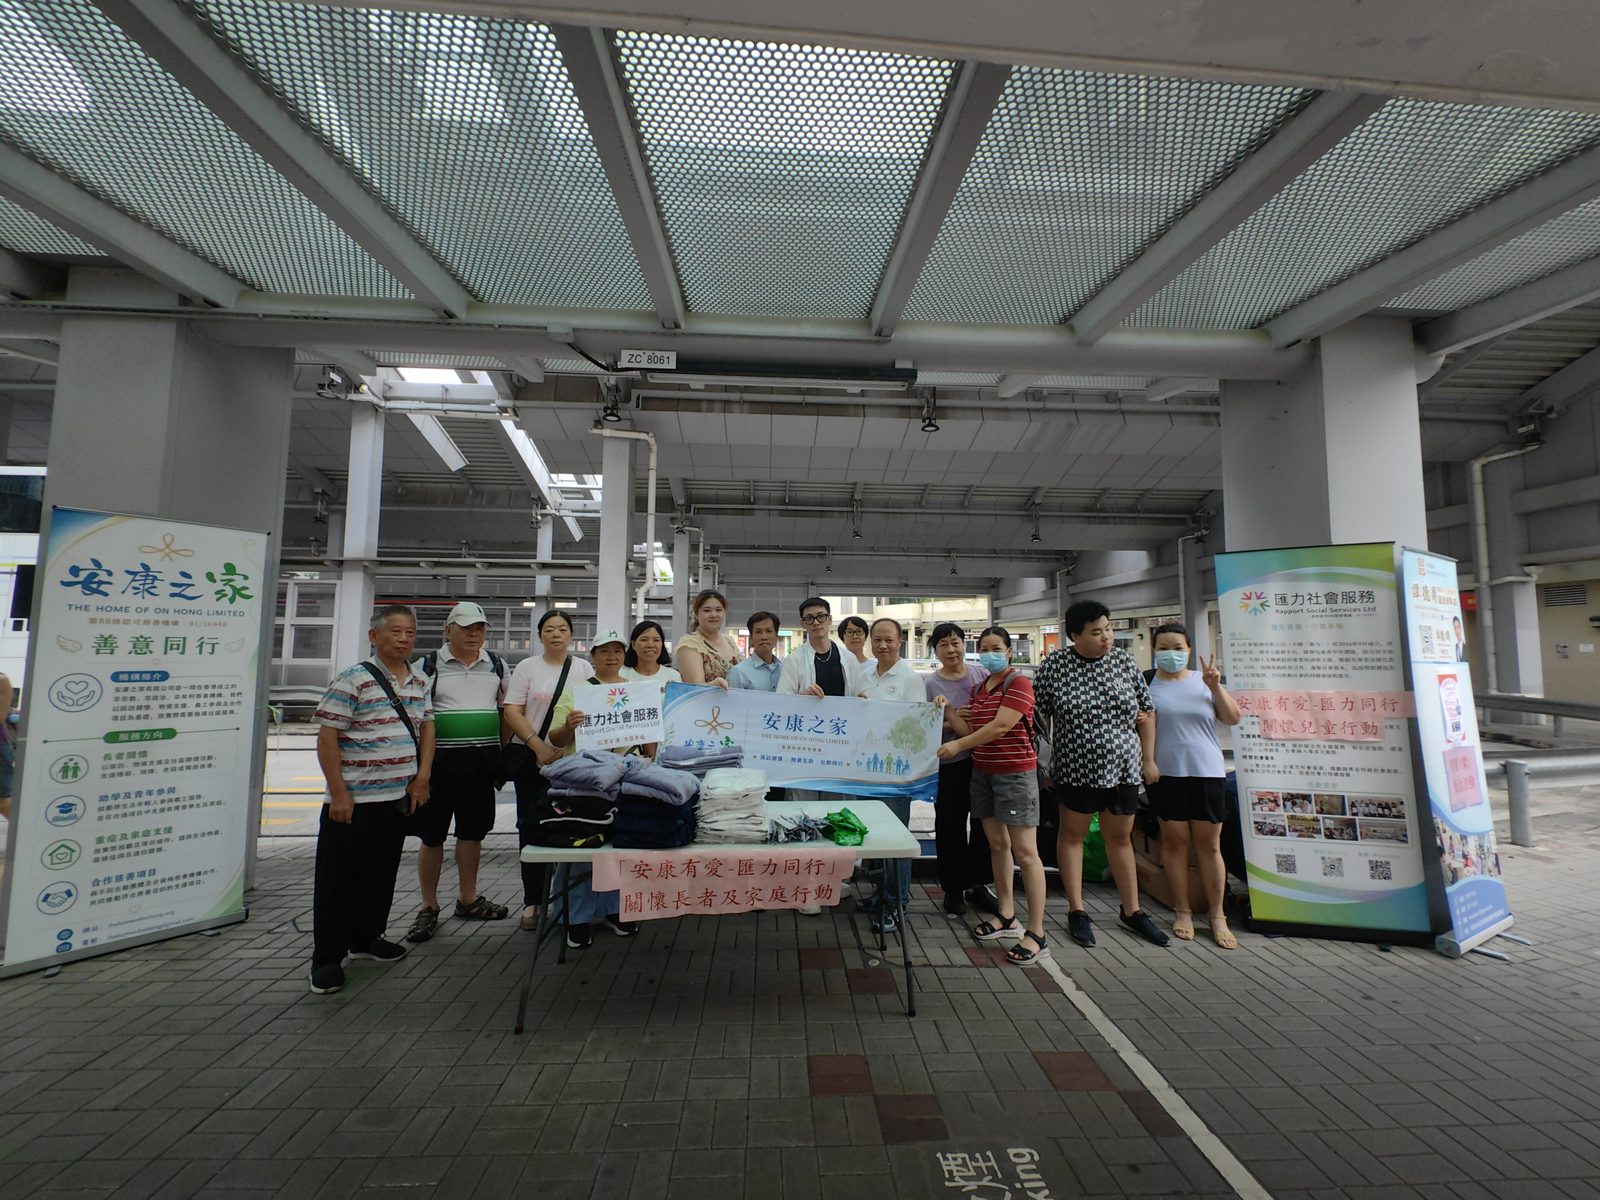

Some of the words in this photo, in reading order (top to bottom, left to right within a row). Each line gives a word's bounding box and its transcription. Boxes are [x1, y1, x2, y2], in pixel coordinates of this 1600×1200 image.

[628, 354, 642, 363] ZC
[647, 355, 670, 364] 8061
[60, 558, 254, 604] 安康之家
[1274, 590, 1375, 606] 匯力社會服務
[66, 604, 91, 612] THE
[96, 604, 130, 614] HOME
[136, 606, 150, 614] OF
[154, 607, 169, 615] ON
[173, 608, 202, 616] HONG
[206, 609, 245, 617] LIMITED
[91, 634, 219, 655] 善意同行
[606, 725, 624, 733] Social
[625, 722, 650, 730] Services
[762, 712, 848, 736] 安康之家
[1262, 719, 1379, 736] 關懷兒童行動
[118, 730, 163, 741] 服務方向
[624, 884, 833, 914] 關懷長者及家庭行動
